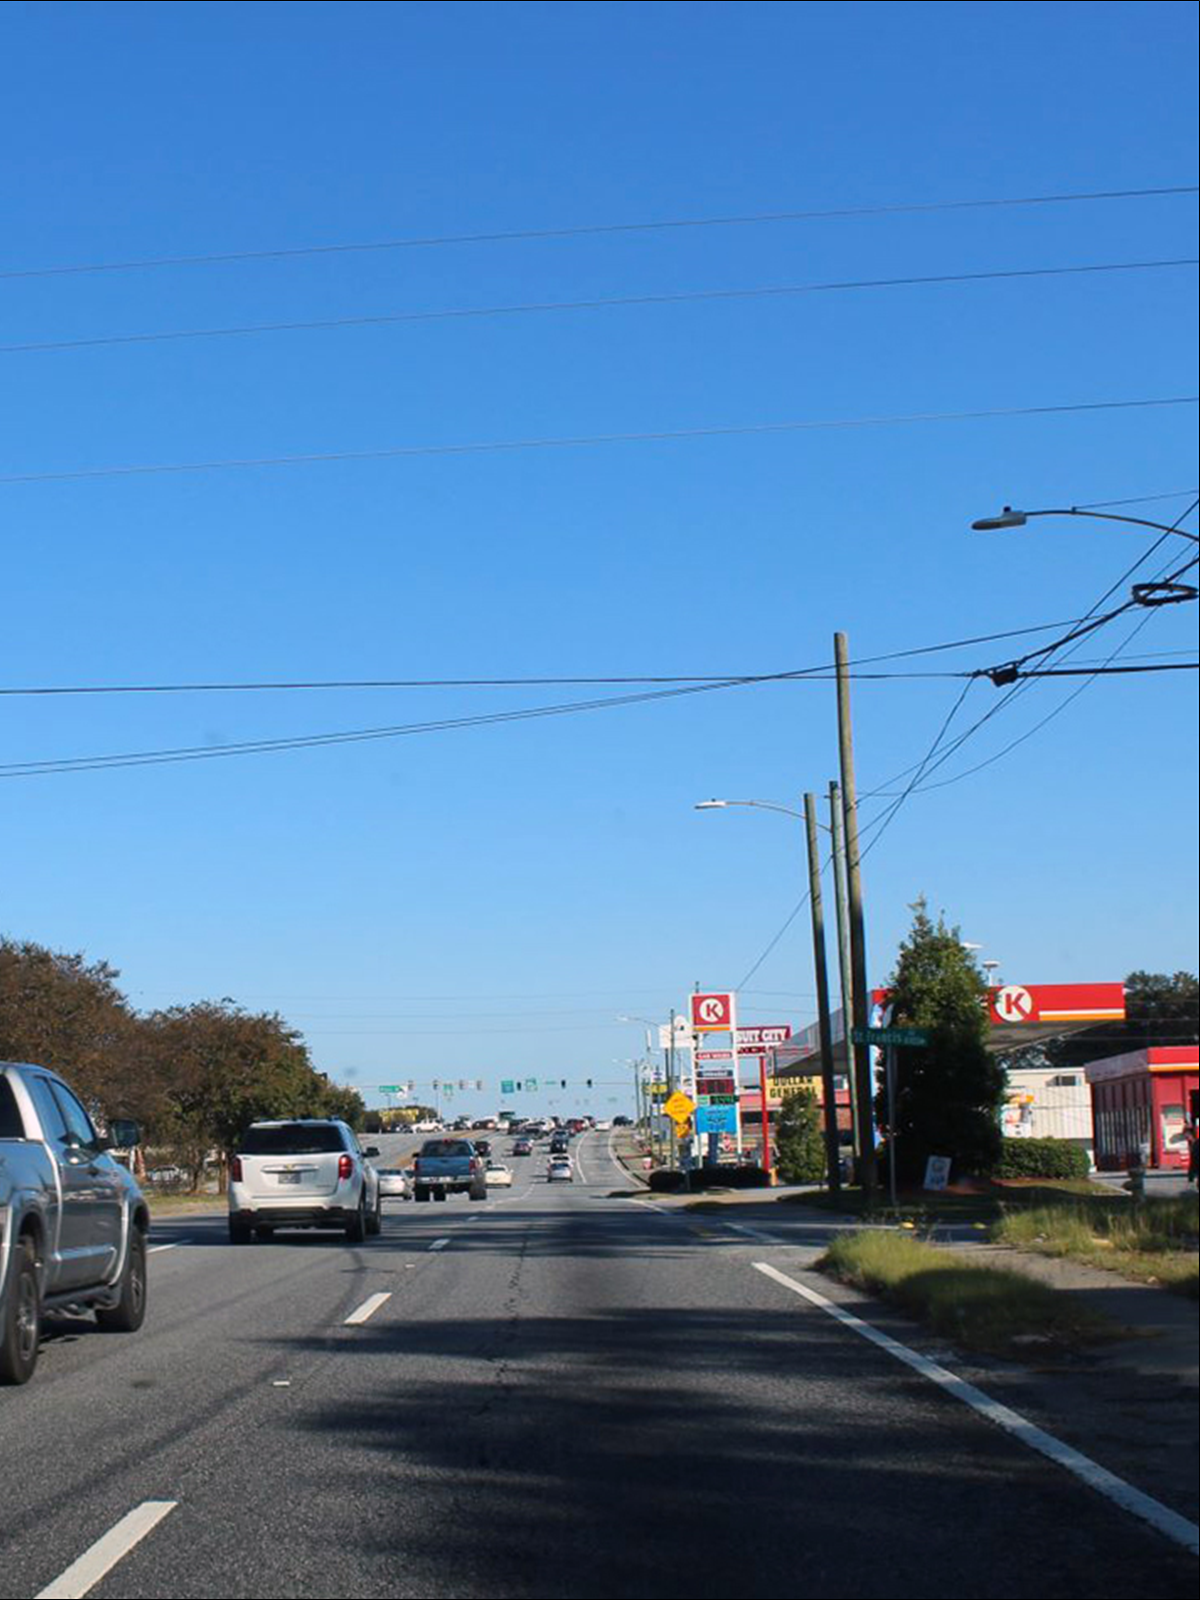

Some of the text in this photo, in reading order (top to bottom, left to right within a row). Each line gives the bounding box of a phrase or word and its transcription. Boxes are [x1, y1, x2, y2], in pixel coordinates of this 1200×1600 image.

[706, 1003, 721, 1019] K
[1006, 993, 1027, 1018] K
[762, 1028, 787, 1042] CITY
